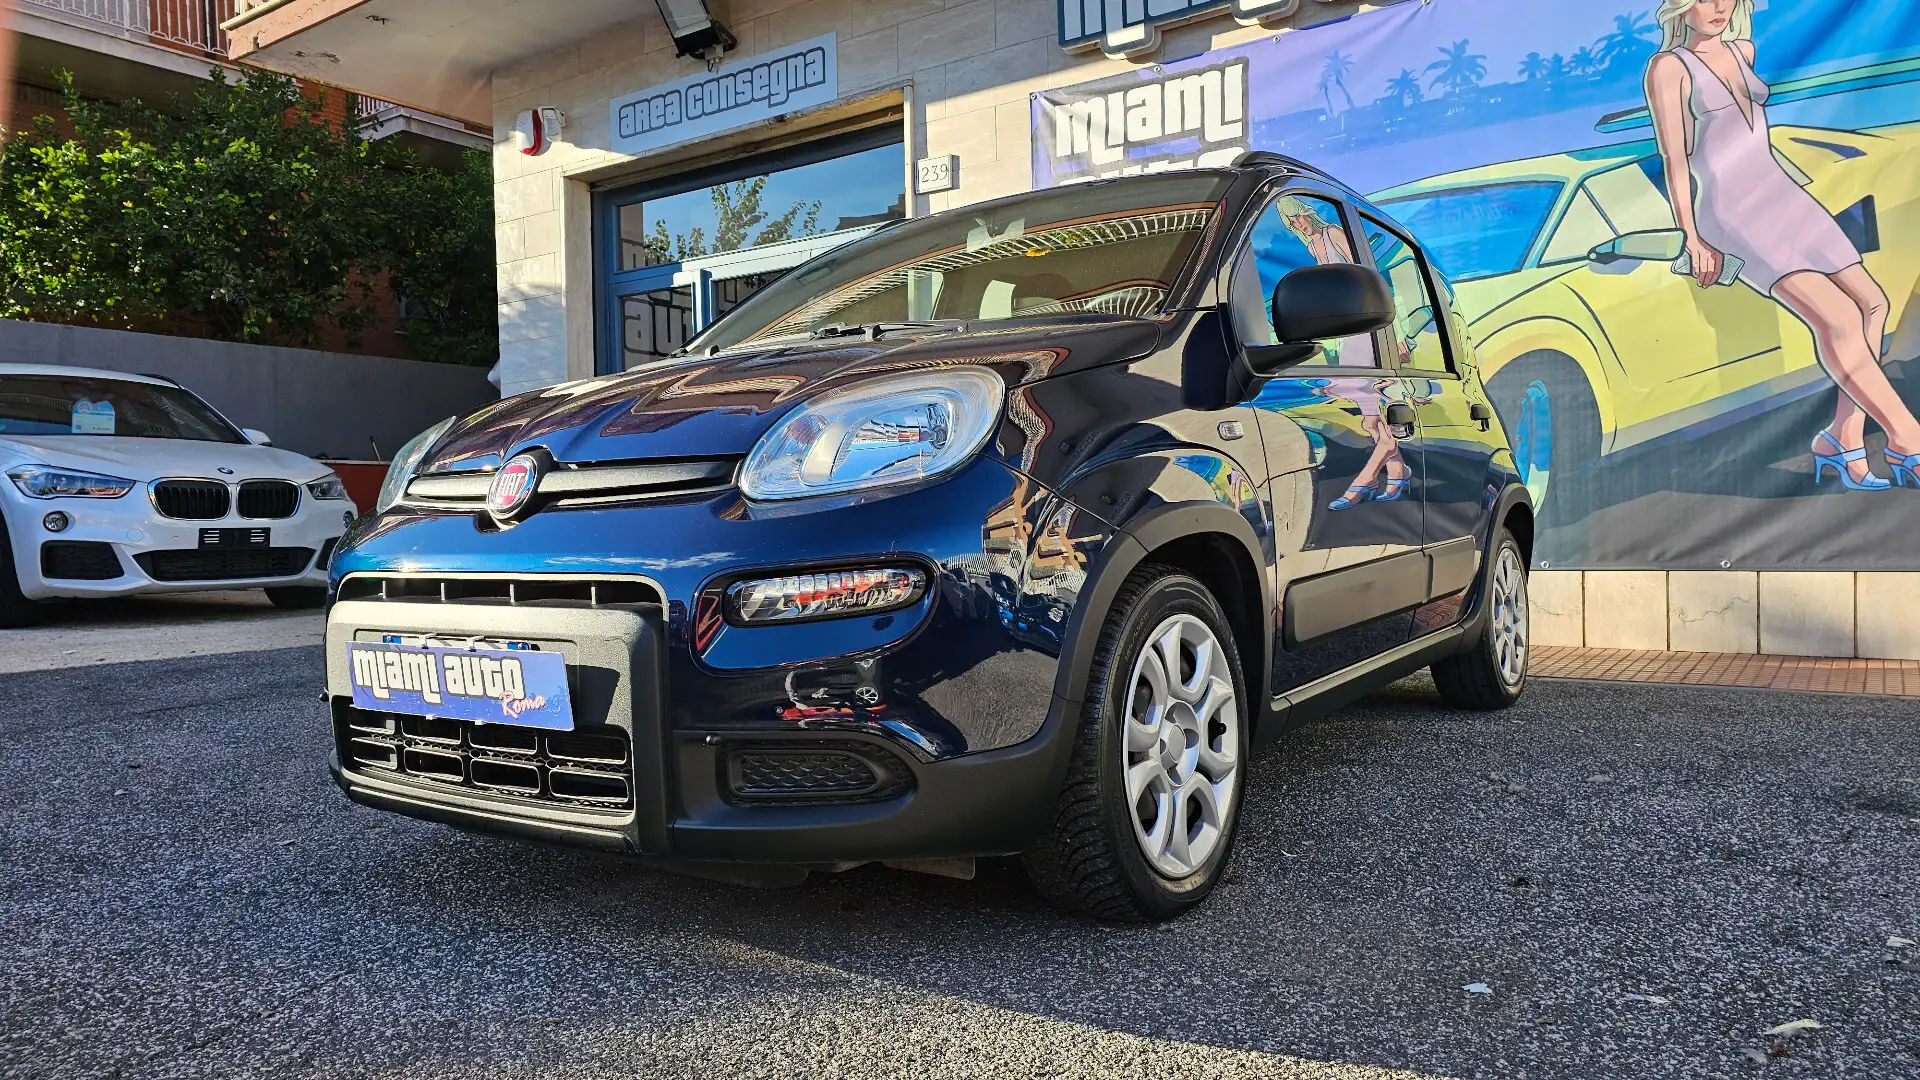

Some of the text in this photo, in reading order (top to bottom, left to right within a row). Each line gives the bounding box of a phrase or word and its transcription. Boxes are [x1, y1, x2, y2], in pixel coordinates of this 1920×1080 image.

[685, 46, 826, 109] consegna
[921, 163, 948, 184] 239
[495, 472, 525, 499] FIAT
[443, 652, 526, 702] auto
[498, 690, 546, 719] Roma
